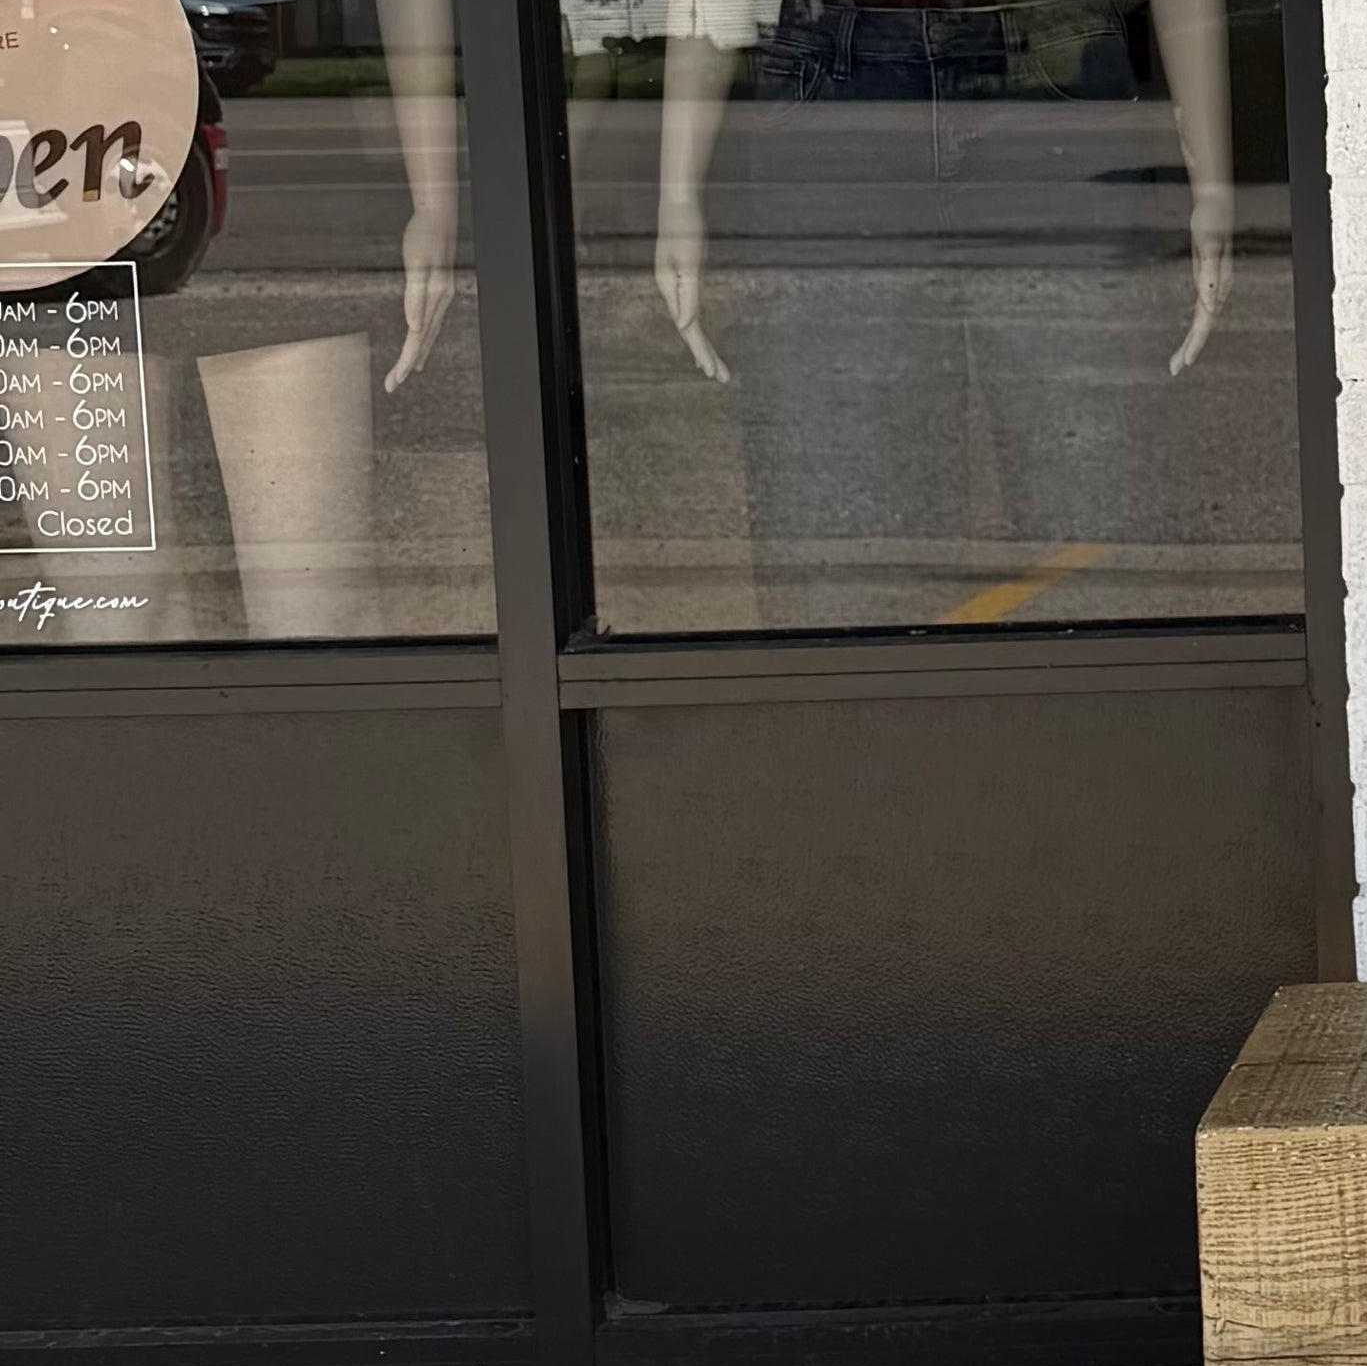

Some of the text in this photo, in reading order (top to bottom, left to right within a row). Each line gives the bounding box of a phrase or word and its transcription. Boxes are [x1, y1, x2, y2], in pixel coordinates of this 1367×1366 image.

[0, 301, 36, 322] AM
[65, 291, 119, 324] 6PM
[66, 327, 121, 359] 6PM
[69, 363, 124, 394] 6PM
[72, 399, 126, 430] 6PM
[75, 435, 129, 466] 6PM
[77, 470, 131, 501] 6PM
[37, 509, 133, 536] Closed
